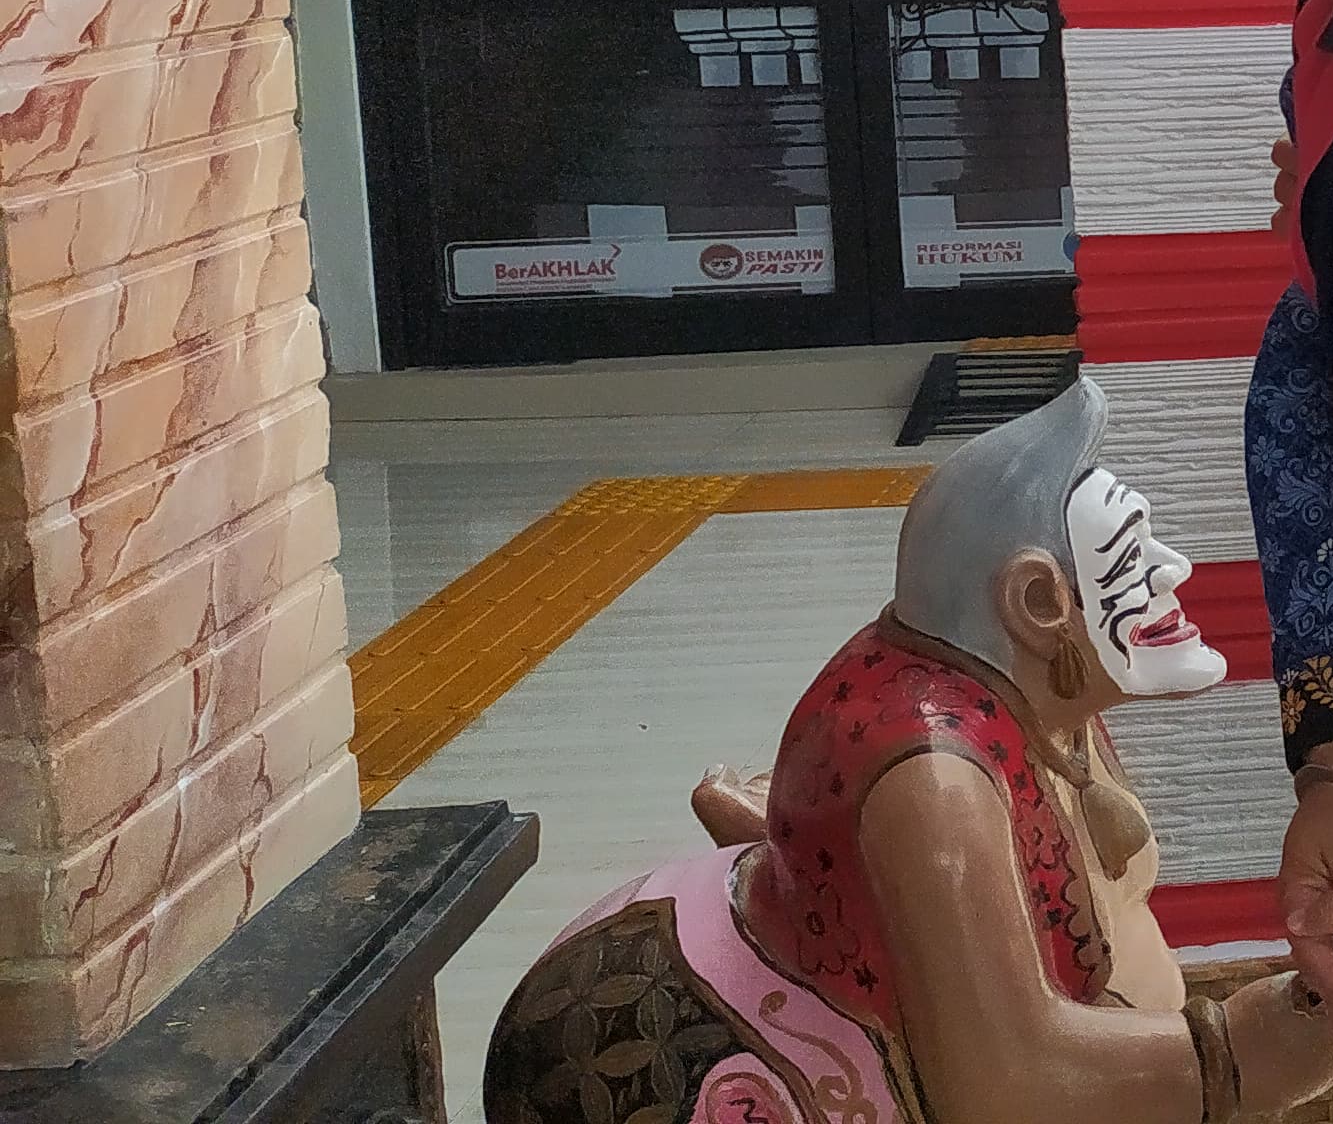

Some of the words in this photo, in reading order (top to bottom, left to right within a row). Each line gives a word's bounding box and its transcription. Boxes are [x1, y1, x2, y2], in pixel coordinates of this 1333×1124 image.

[917, 240, 1022, 253] REFORMASI
[744, 249, 824, 263] SEMAKIN
[917, 251, 1024, 265] HUKUM
[746, 261, 824, 276] PASTI
